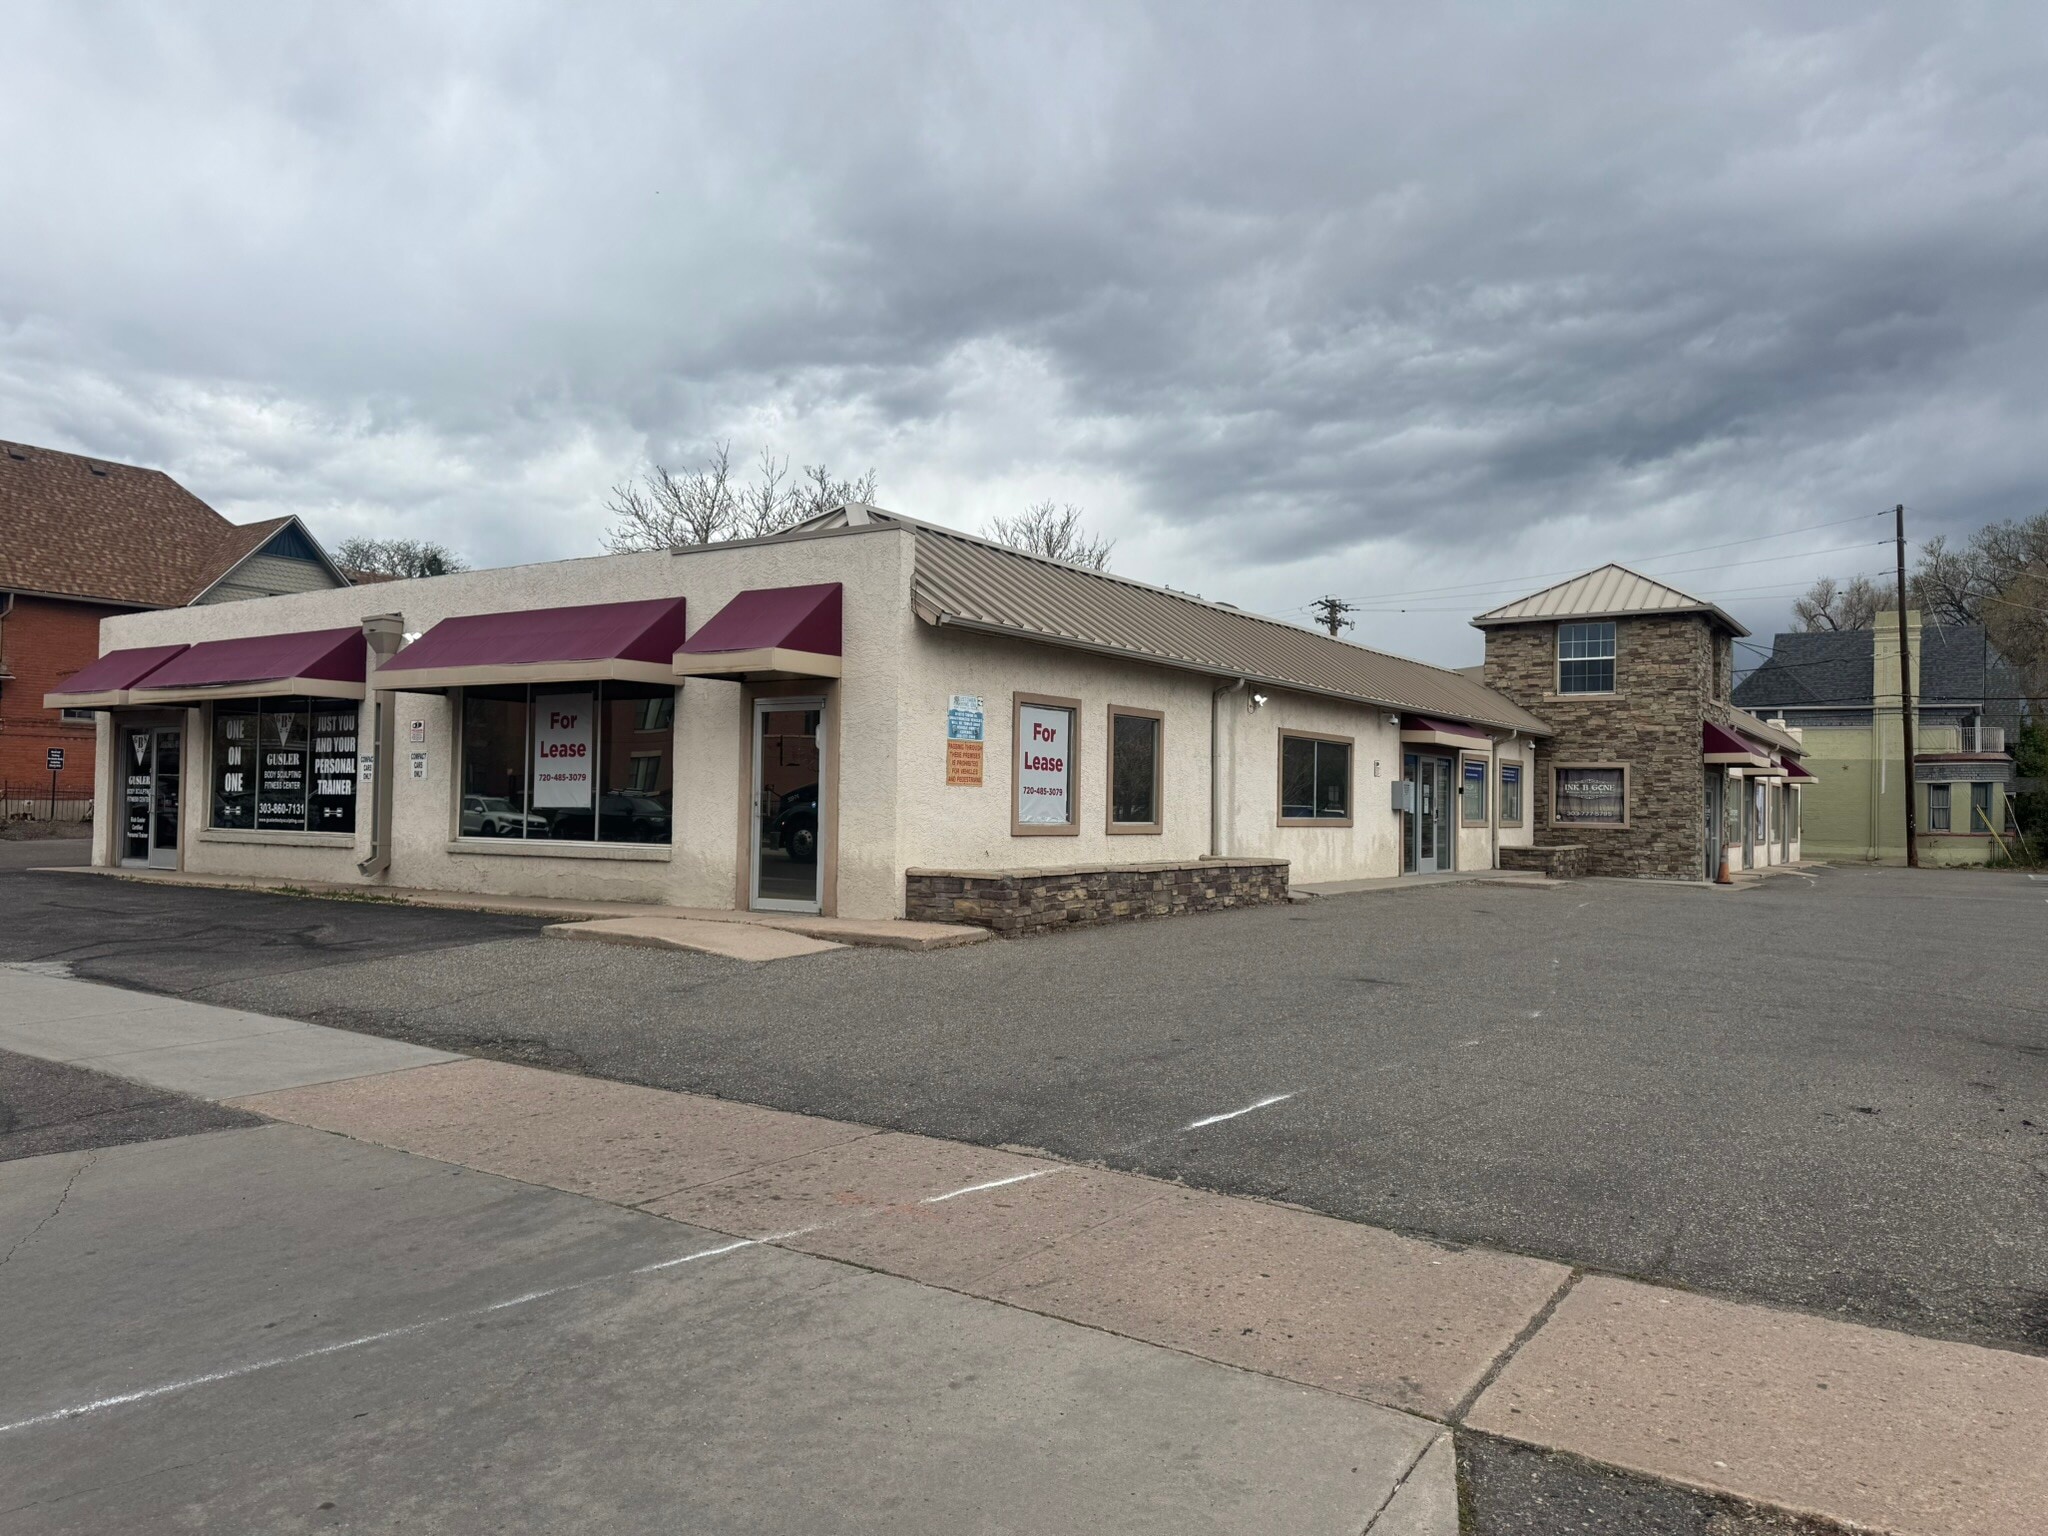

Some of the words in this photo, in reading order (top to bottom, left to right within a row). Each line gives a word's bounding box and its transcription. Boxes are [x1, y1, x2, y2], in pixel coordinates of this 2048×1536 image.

[317, 716, 337, 732] JUST
[338, 715, 355, 731] YOU
[550, 711, 577, 729] For
[226, 719, 245, 740] ONE
[1033, 722, 1057, 743] For
[315, 737, 333, 753] AND
[333, 736, 356, 753] YOUR
[540, 740, 587, 758] Lease
[228, 746, 241, 766] ON
[266, 753, 300, 766] GUSLER
[410, 752, 427, 760] COMPACT
[1024, 751, 1064, 773] Lease
[263, 770, 276, 779] BODY
[277, 770, 302, 779] SCULPTING
[314, 758, 356, 774] PERSONAL
[128, 775, 150, 785] GUSLER
[224, 772, 243, 792] ONE
[264, 781, 282, 790] FITNESS
[282, 781, 301, 790] CENTER
[538, 773, 587, 782] 720-485-3079
[317, 779, 352, 796] TRAINER
[1023, 786, 1063, 797] 720-485-3079
[259, 802, 305, 815] 303-860-7131
